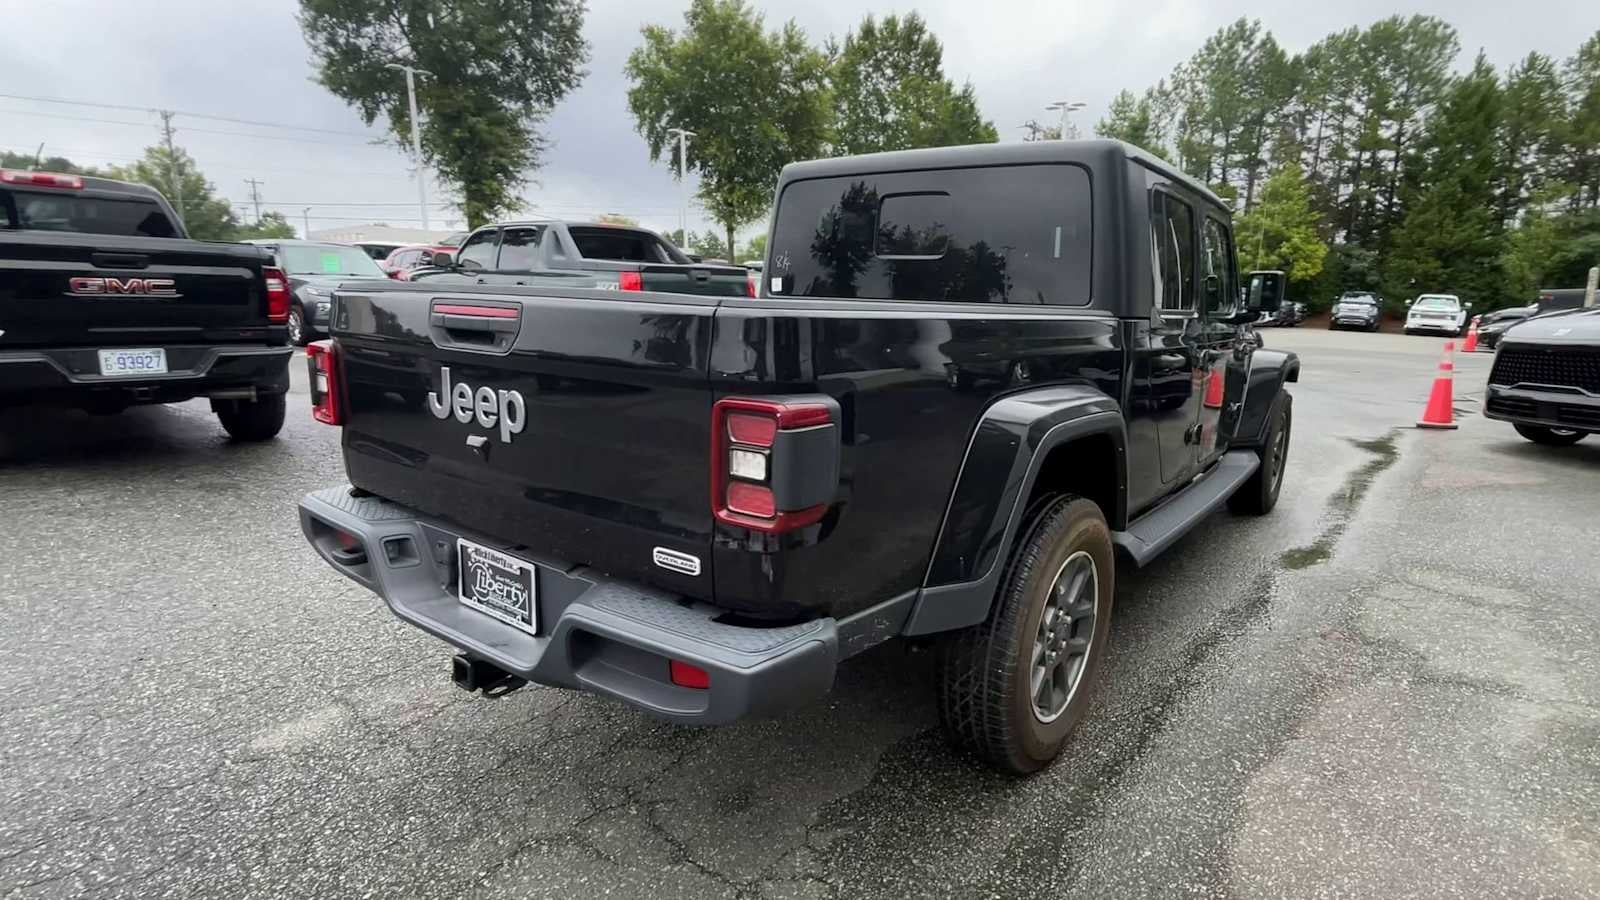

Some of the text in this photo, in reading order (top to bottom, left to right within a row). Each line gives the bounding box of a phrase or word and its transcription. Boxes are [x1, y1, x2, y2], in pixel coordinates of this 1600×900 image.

[69, 277, 177, 294] GMC
[116, 355, 161, 370] 93927
[428, 366, 526, 443] Jeep
[475, 568, 526, 608] Liberty
